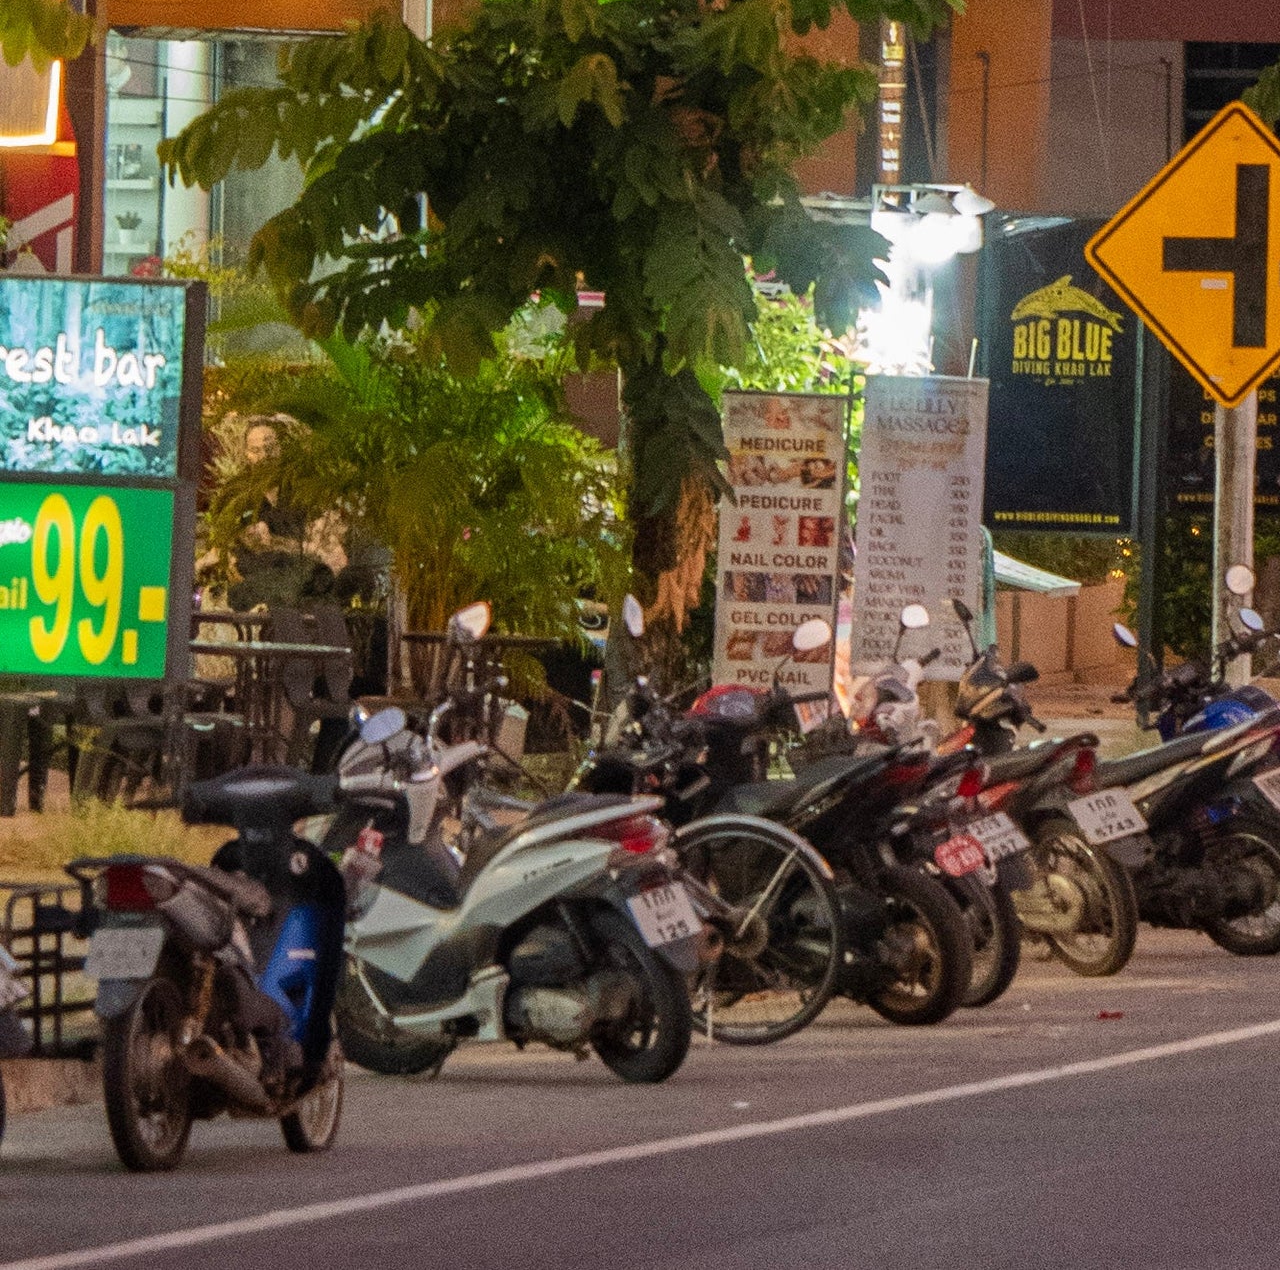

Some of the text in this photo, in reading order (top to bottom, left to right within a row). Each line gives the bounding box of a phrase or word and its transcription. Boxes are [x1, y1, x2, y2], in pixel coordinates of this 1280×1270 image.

[1013, 317, 1113, 361] BIG BLUE
[0, 327, 166, 390] est bar
[1012, 360, 1112, 376] DIVING KHAO LAK
[27, 416, 163, 448] Khao Lak
[740, 436, 826, 452] MEDICURE
[740, 494, 823, 510] PEDICURE
[730, 553, 828, 569] NAIL COLOR
[730, 610, 822, 626] GEL COLO
[736, 670, 770, 683] PVC
